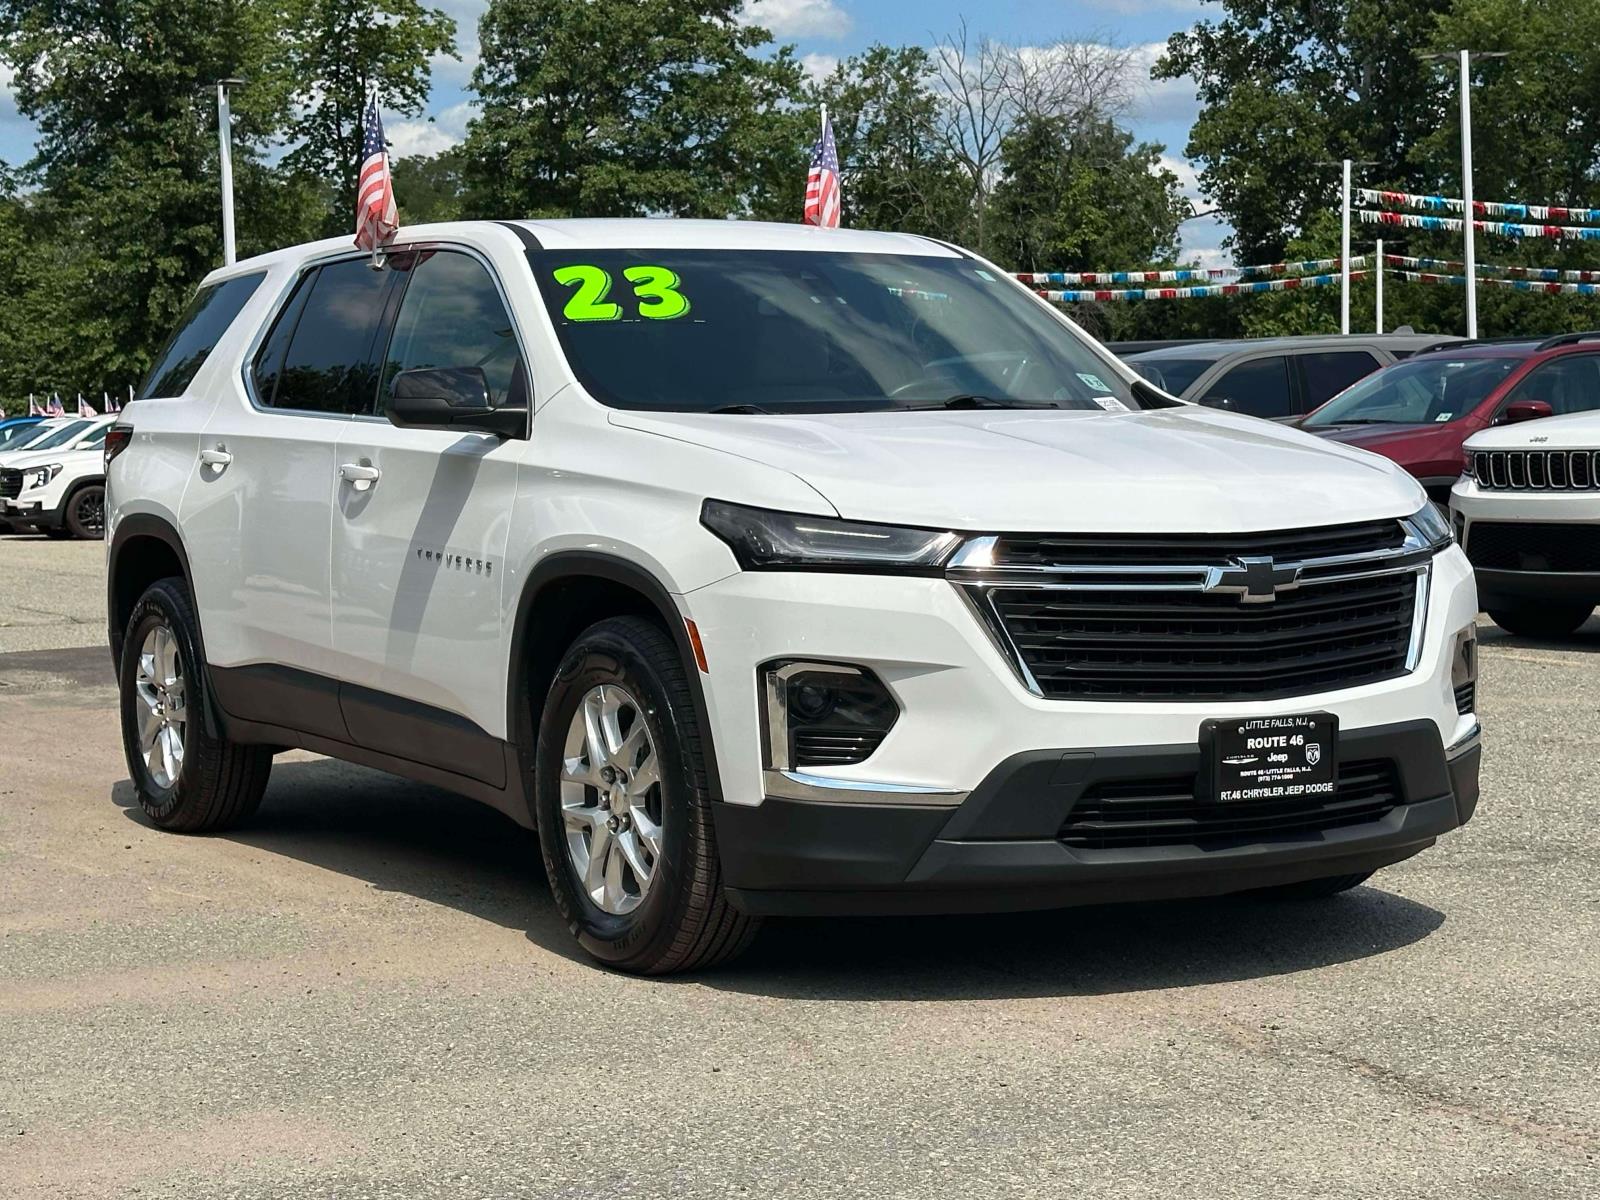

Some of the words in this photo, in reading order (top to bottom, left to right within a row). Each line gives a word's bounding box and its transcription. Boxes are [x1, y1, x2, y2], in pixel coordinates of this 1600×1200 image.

[553, 265, 692, 321] 23
[1529, 436, 1548, 444] Jeep
[417, 549, 492, 577] TRAVERSE
[1245, 720, 1270, 730] LITTLE
[1270, 718, 1294, 729] FALLS,
[1295, 717, 1308, 726] N.J.
[1247, 736, 1287, 750] ROUTE
[1289, 735, 1304, 746] 46
[1267, 752, 1288, 763] Jeep
[1242, 786, 1284, 799] CHRYSLER
[1284, 784, 1305, 795] JEEP
[1305, 782, 1333, 794] DODGE
